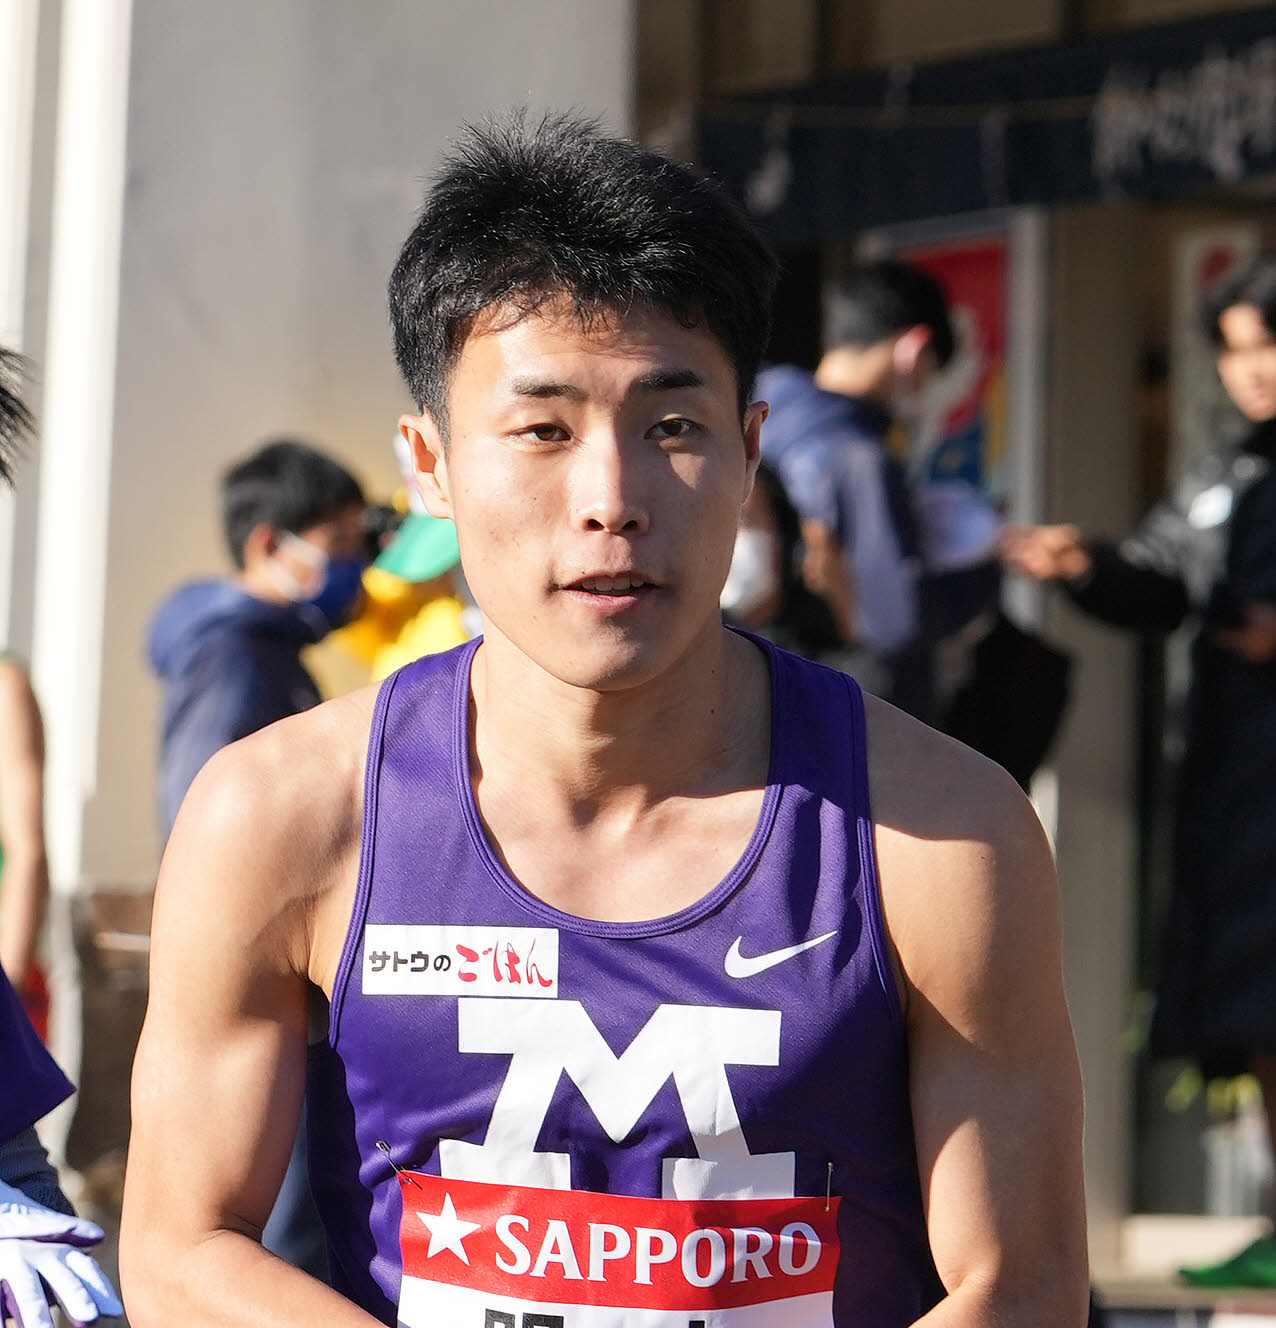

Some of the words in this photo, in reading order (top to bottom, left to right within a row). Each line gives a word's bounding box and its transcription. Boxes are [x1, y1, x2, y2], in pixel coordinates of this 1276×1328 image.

[369, 938, 553, 988] サトウのごはん
[438, 997, 797, 1199] M
[495, 1214, 821, 1288] SAPPORO
